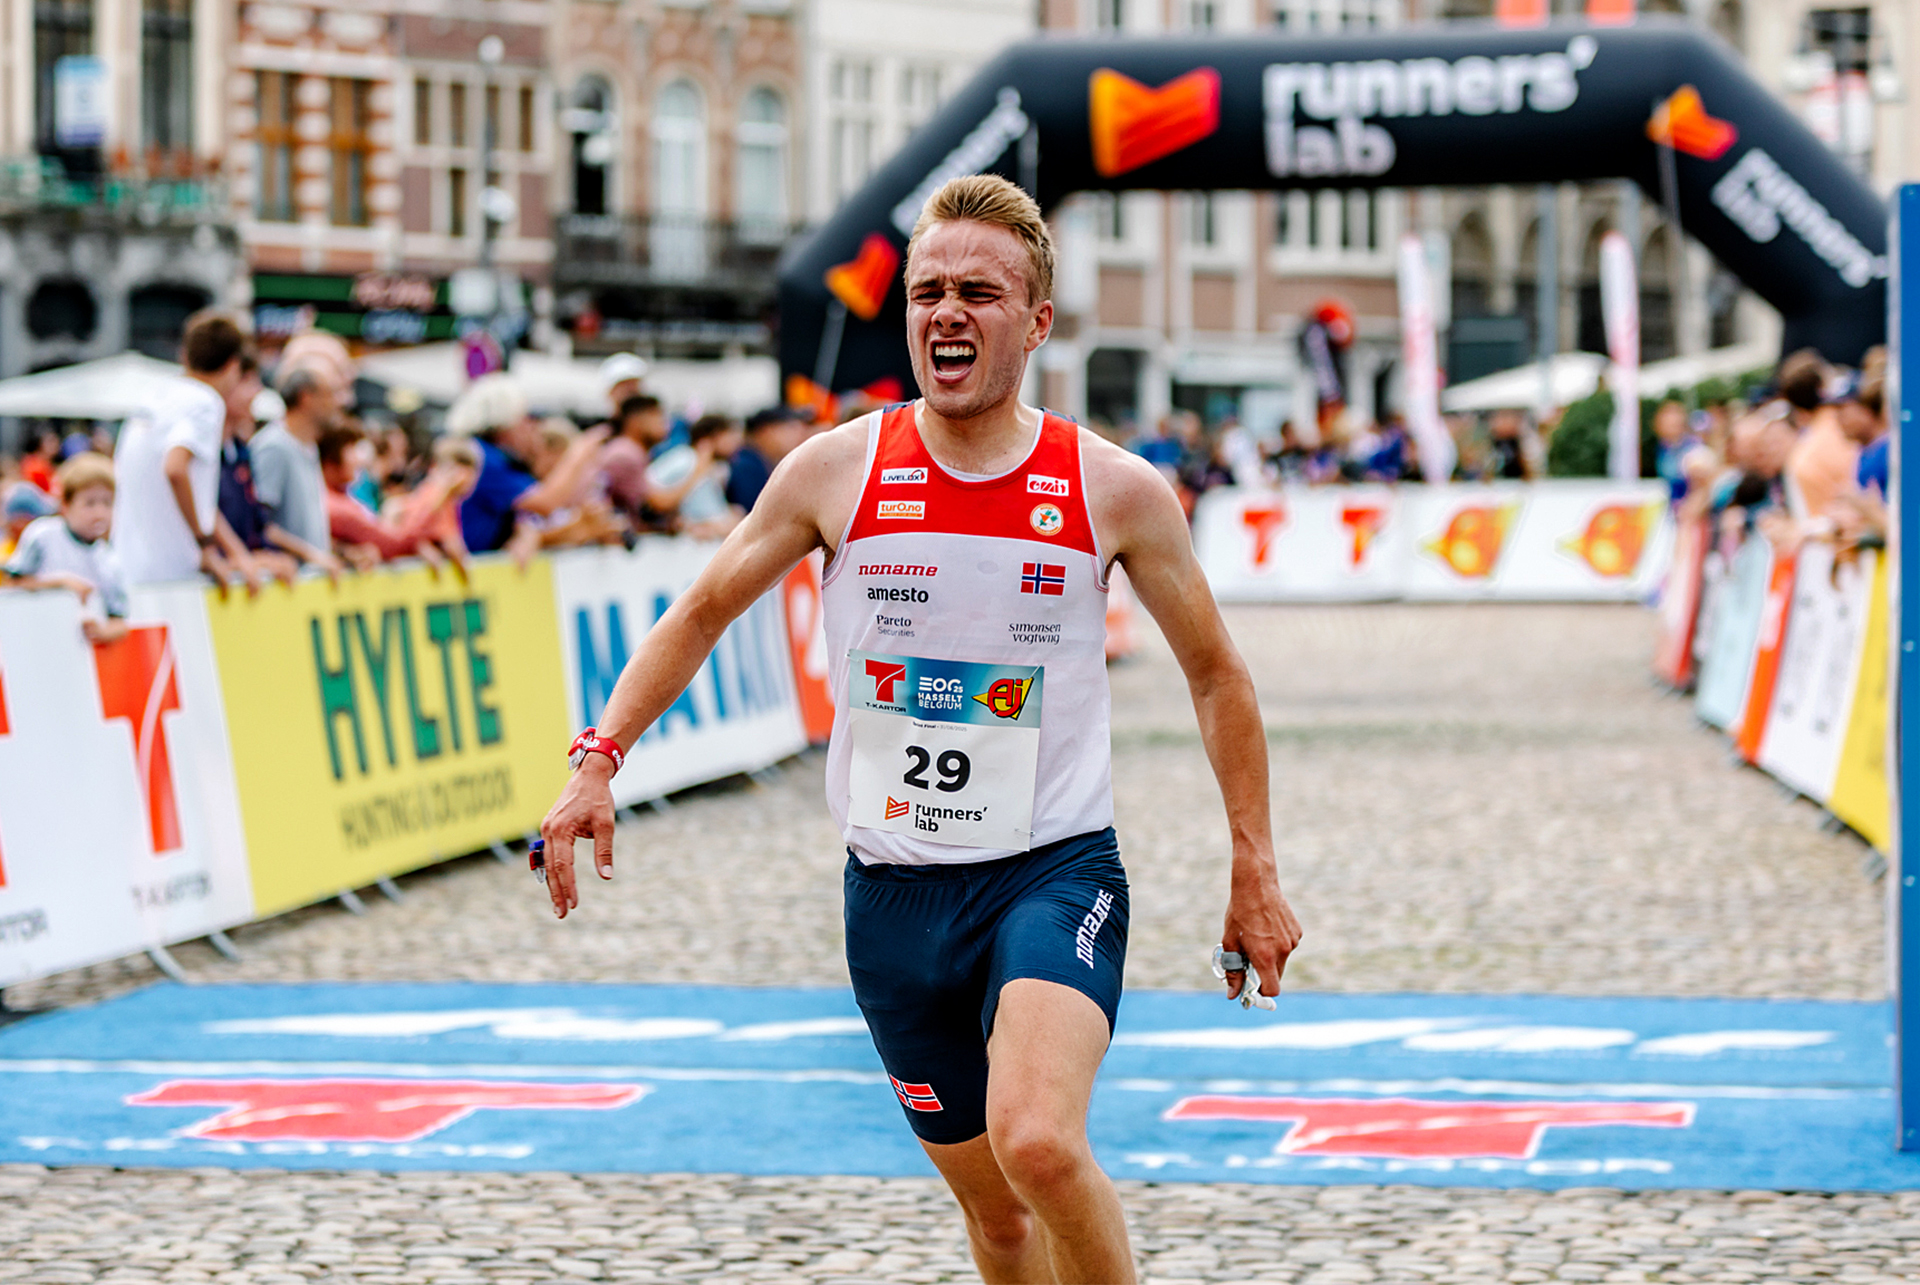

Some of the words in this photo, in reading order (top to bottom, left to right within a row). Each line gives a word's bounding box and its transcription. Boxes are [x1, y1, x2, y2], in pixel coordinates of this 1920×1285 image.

[1264, 114, 1397, 178] lab
[882, 474, 921, 482] LIVELOX
[858, 564, 938, 577] noname
[867, 587, 930, 604] amesto
[876, 614, 912, 628] Pareto
[877, 626, 916, 638] Securities
[310, 597, 504, 781] HYLTE
[917, 691, 963, 703] HASSELT
[865, 702, 907, 714] T-KARTOR
[918, 699, 962, 711] BELGIUM
[903, 745, 971, 793] 29
[915, 803, 988, 822] runners'
[914, 815, 939, 833] lab
